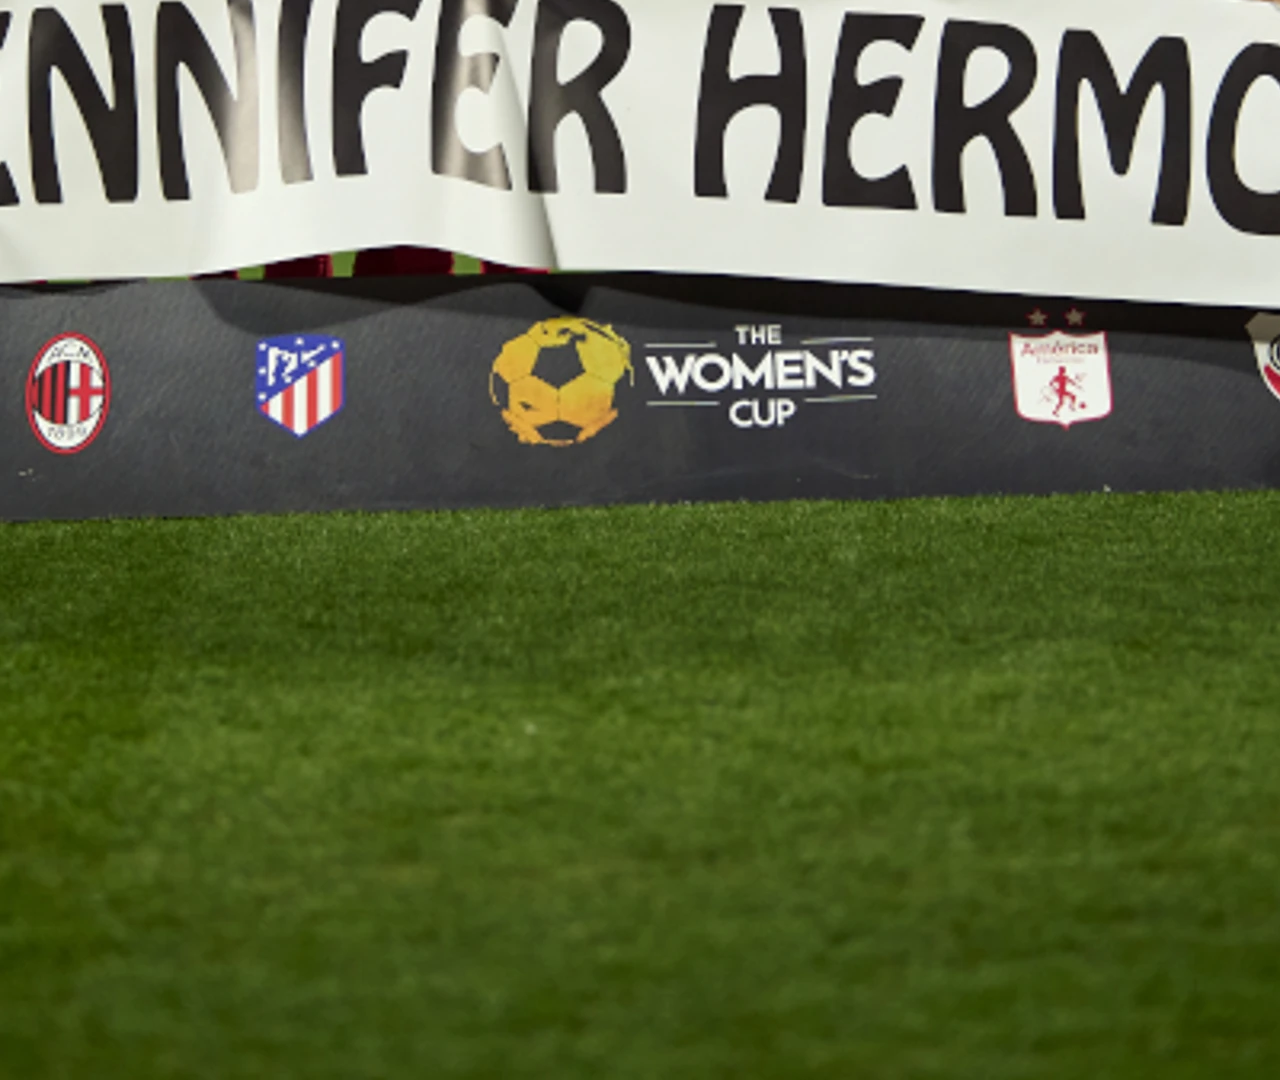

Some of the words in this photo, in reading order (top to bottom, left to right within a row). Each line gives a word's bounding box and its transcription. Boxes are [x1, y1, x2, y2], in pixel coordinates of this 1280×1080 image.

[735, 324, 783, 346] THE
[645, 349, 877, 395] WOMEN'S
[728, 397, 797, 428] CUP
